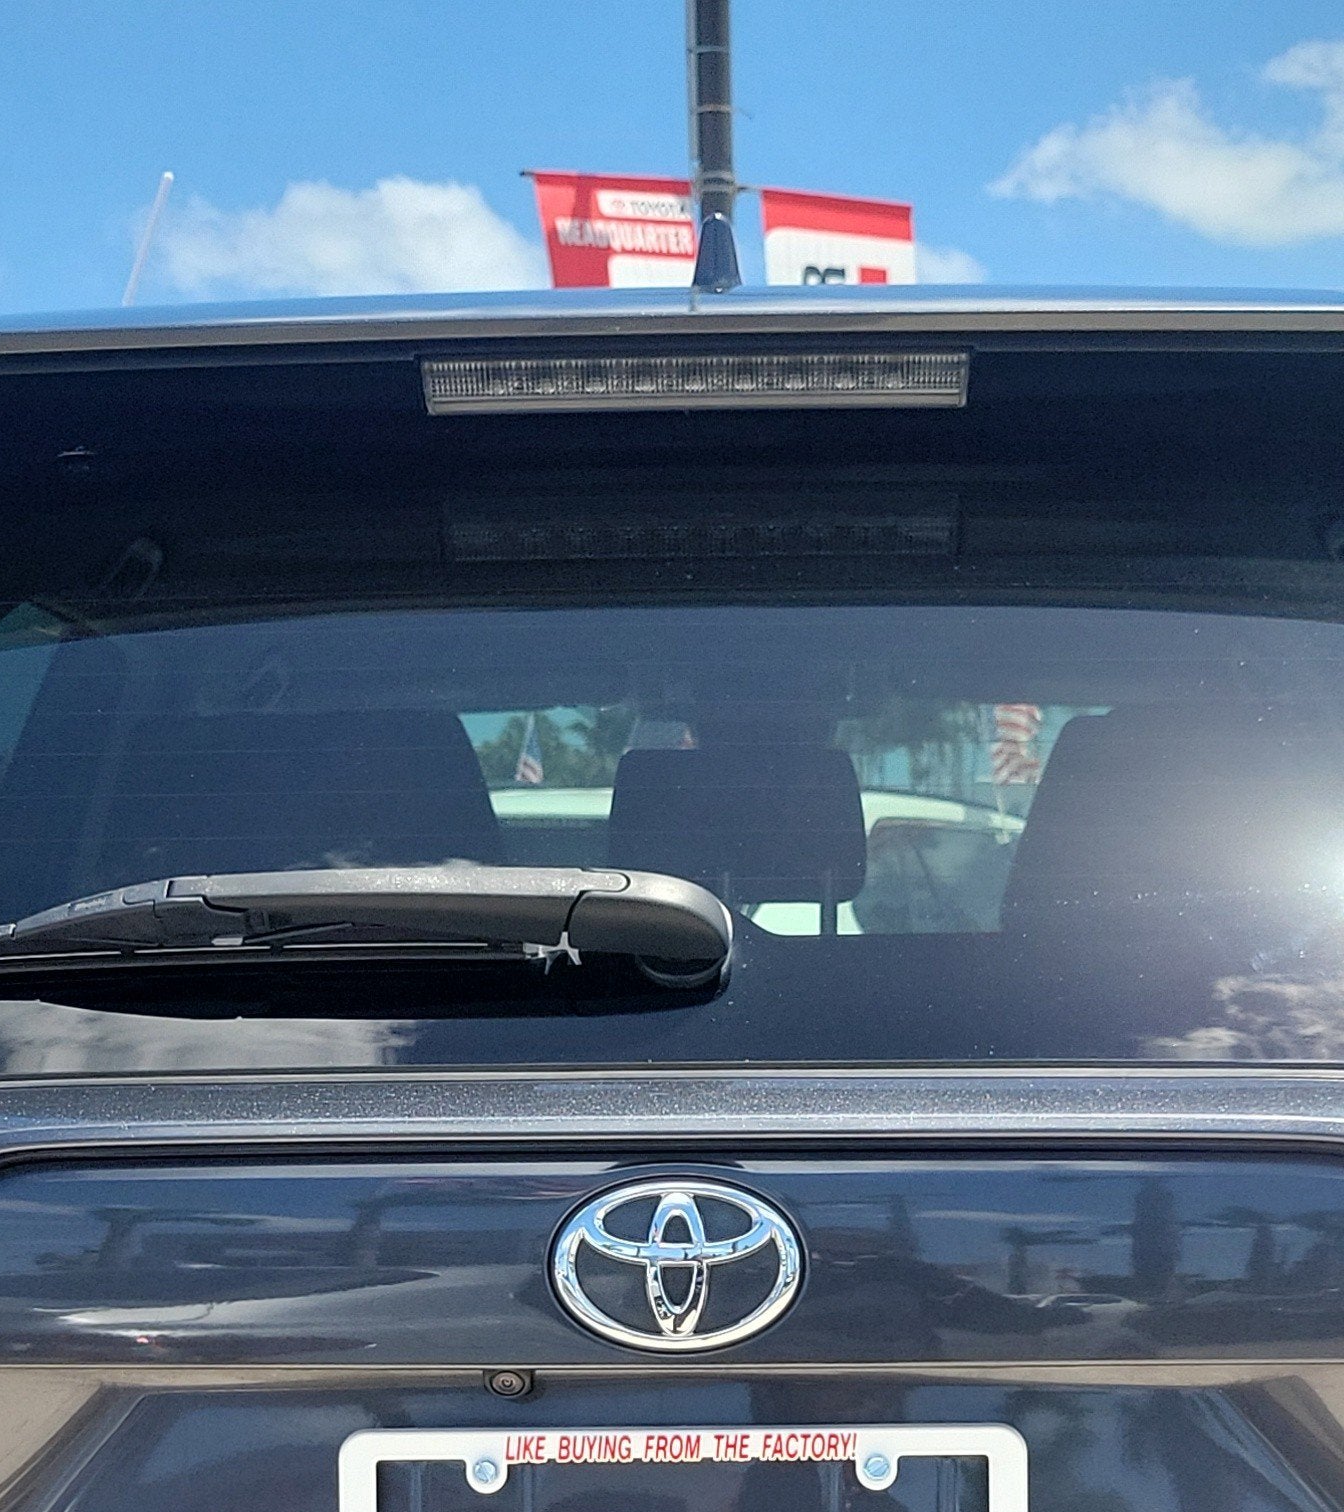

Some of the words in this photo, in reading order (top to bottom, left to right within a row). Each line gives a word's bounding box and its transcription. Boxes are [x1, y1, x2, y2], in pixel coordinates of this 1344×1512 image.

[505, 1435, 546, 1460] LIKE
[558, 1434, 632, 1460] BUYING
[643, 1434, 701, 1460] FROM
[713, 1433, 750, 1459] THE
[761, 1432, 857, 1459] FACTORY!
